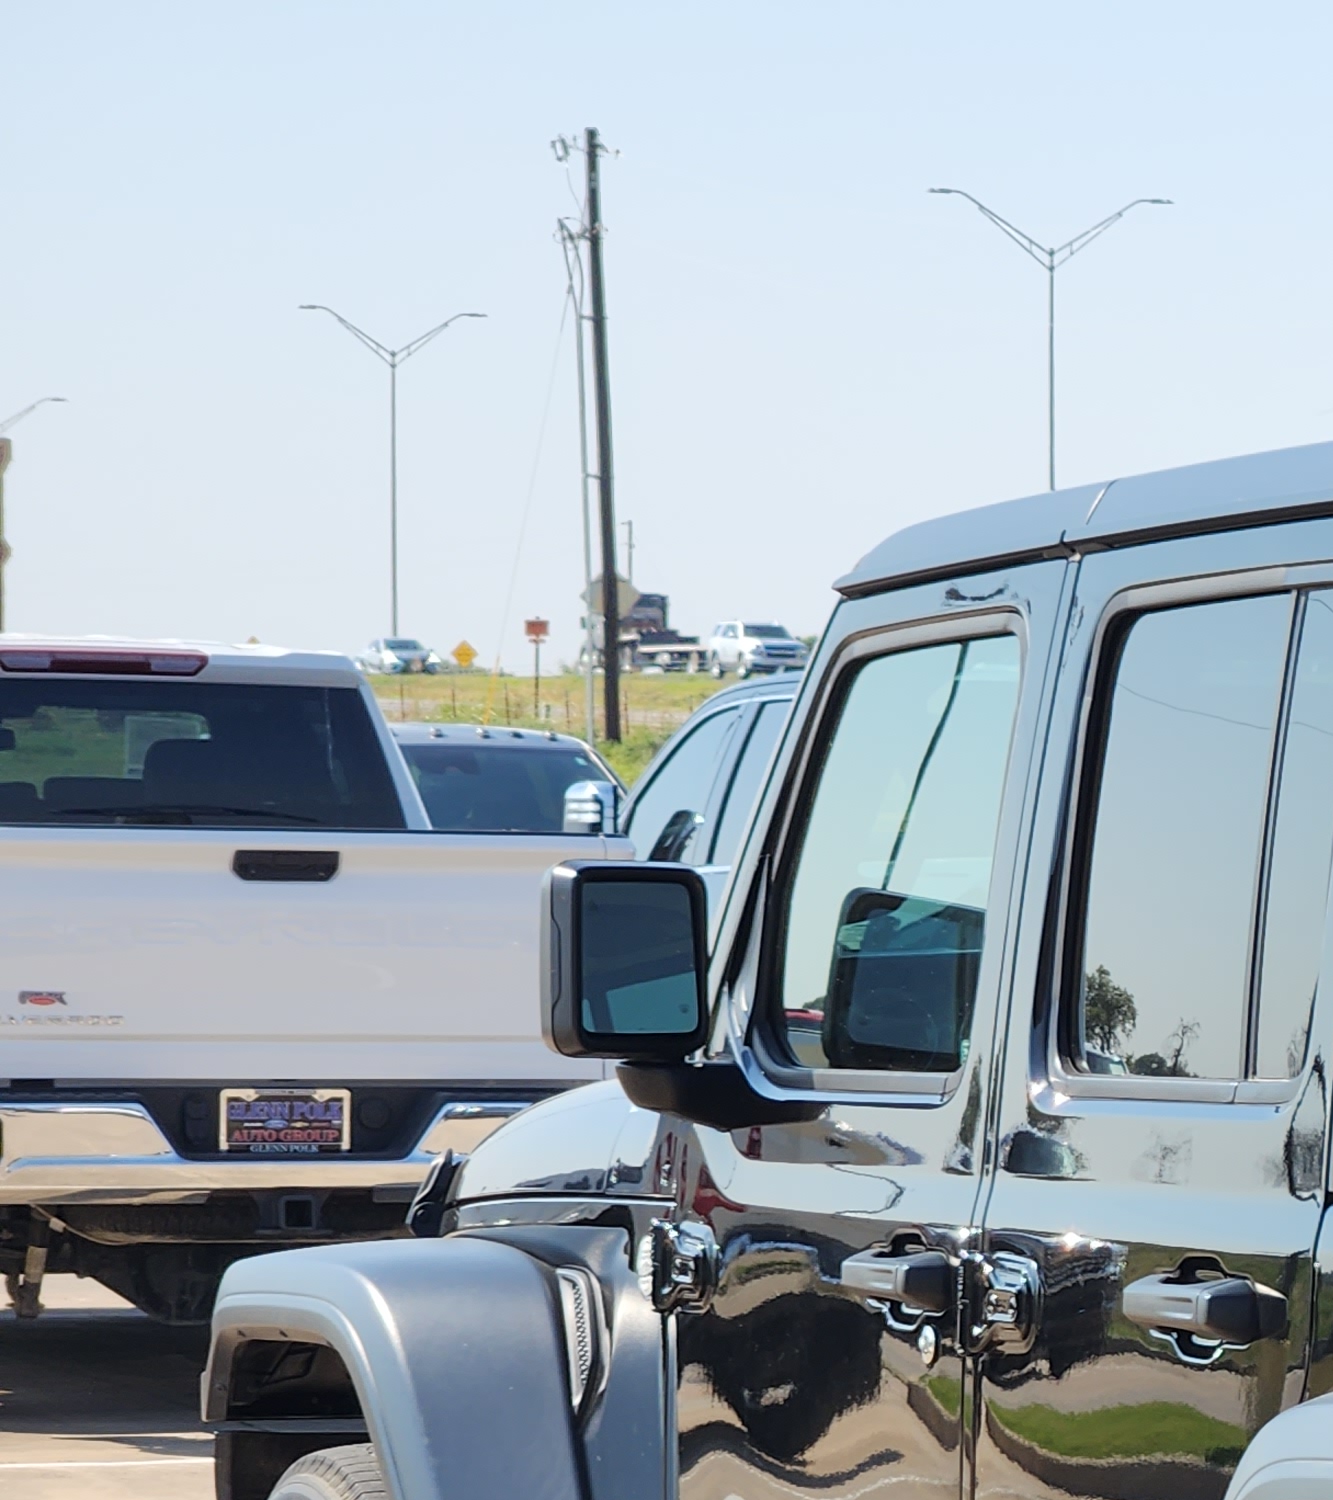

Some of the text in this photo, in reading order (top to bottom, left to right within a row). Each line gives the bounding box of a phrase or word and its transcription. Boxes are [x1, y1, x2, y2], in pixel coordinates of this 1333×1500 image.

[228, 1101, 343, 1119] GLENN POLK
[232, 1129, 340, 1142] AUTO GROUP
[250, 1144, 319, 1153] GLENN POLK
